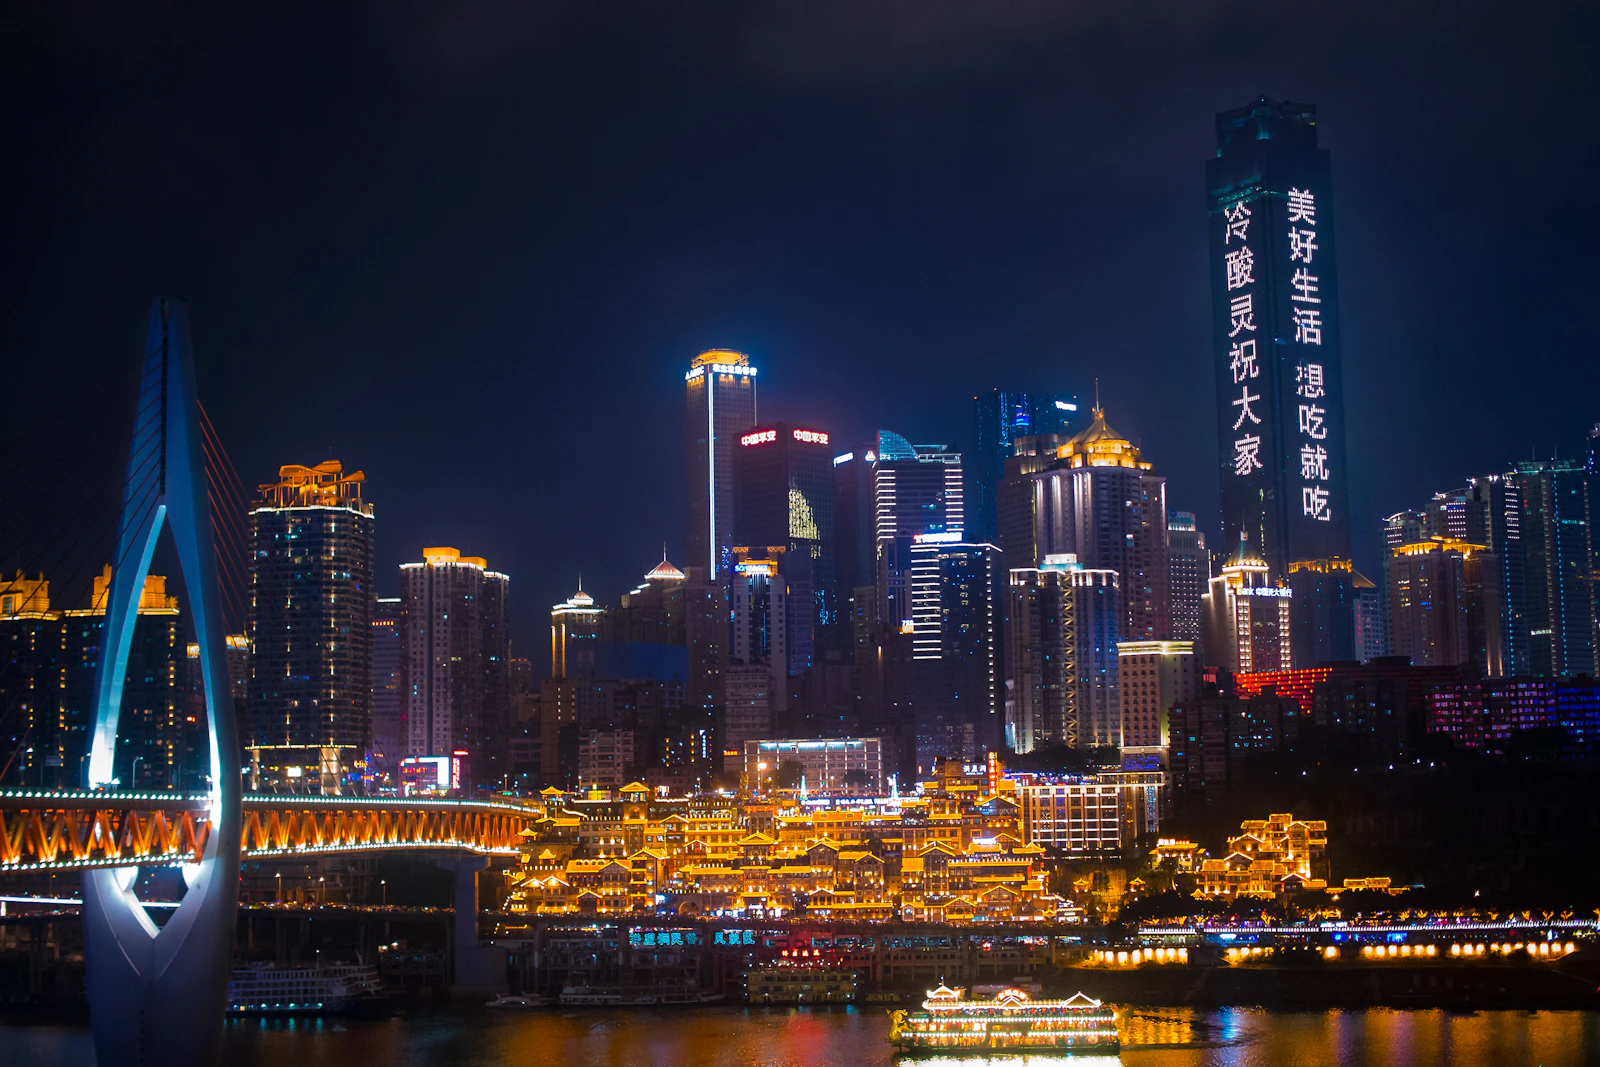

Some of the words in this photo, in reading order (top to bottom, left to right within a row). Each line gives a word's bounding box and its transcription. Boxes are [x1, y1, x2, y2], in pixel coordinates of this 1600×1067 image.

[1224, 201, 1264, 476] 冷酸灵祝大家
[1287, 187, 1323, 346] 美好生活
[741, 430, 777, 446] 中国平安
[793, 429, 829, 445] 中国平安
[1295, 363, 1332, 522] 想吃就吃
